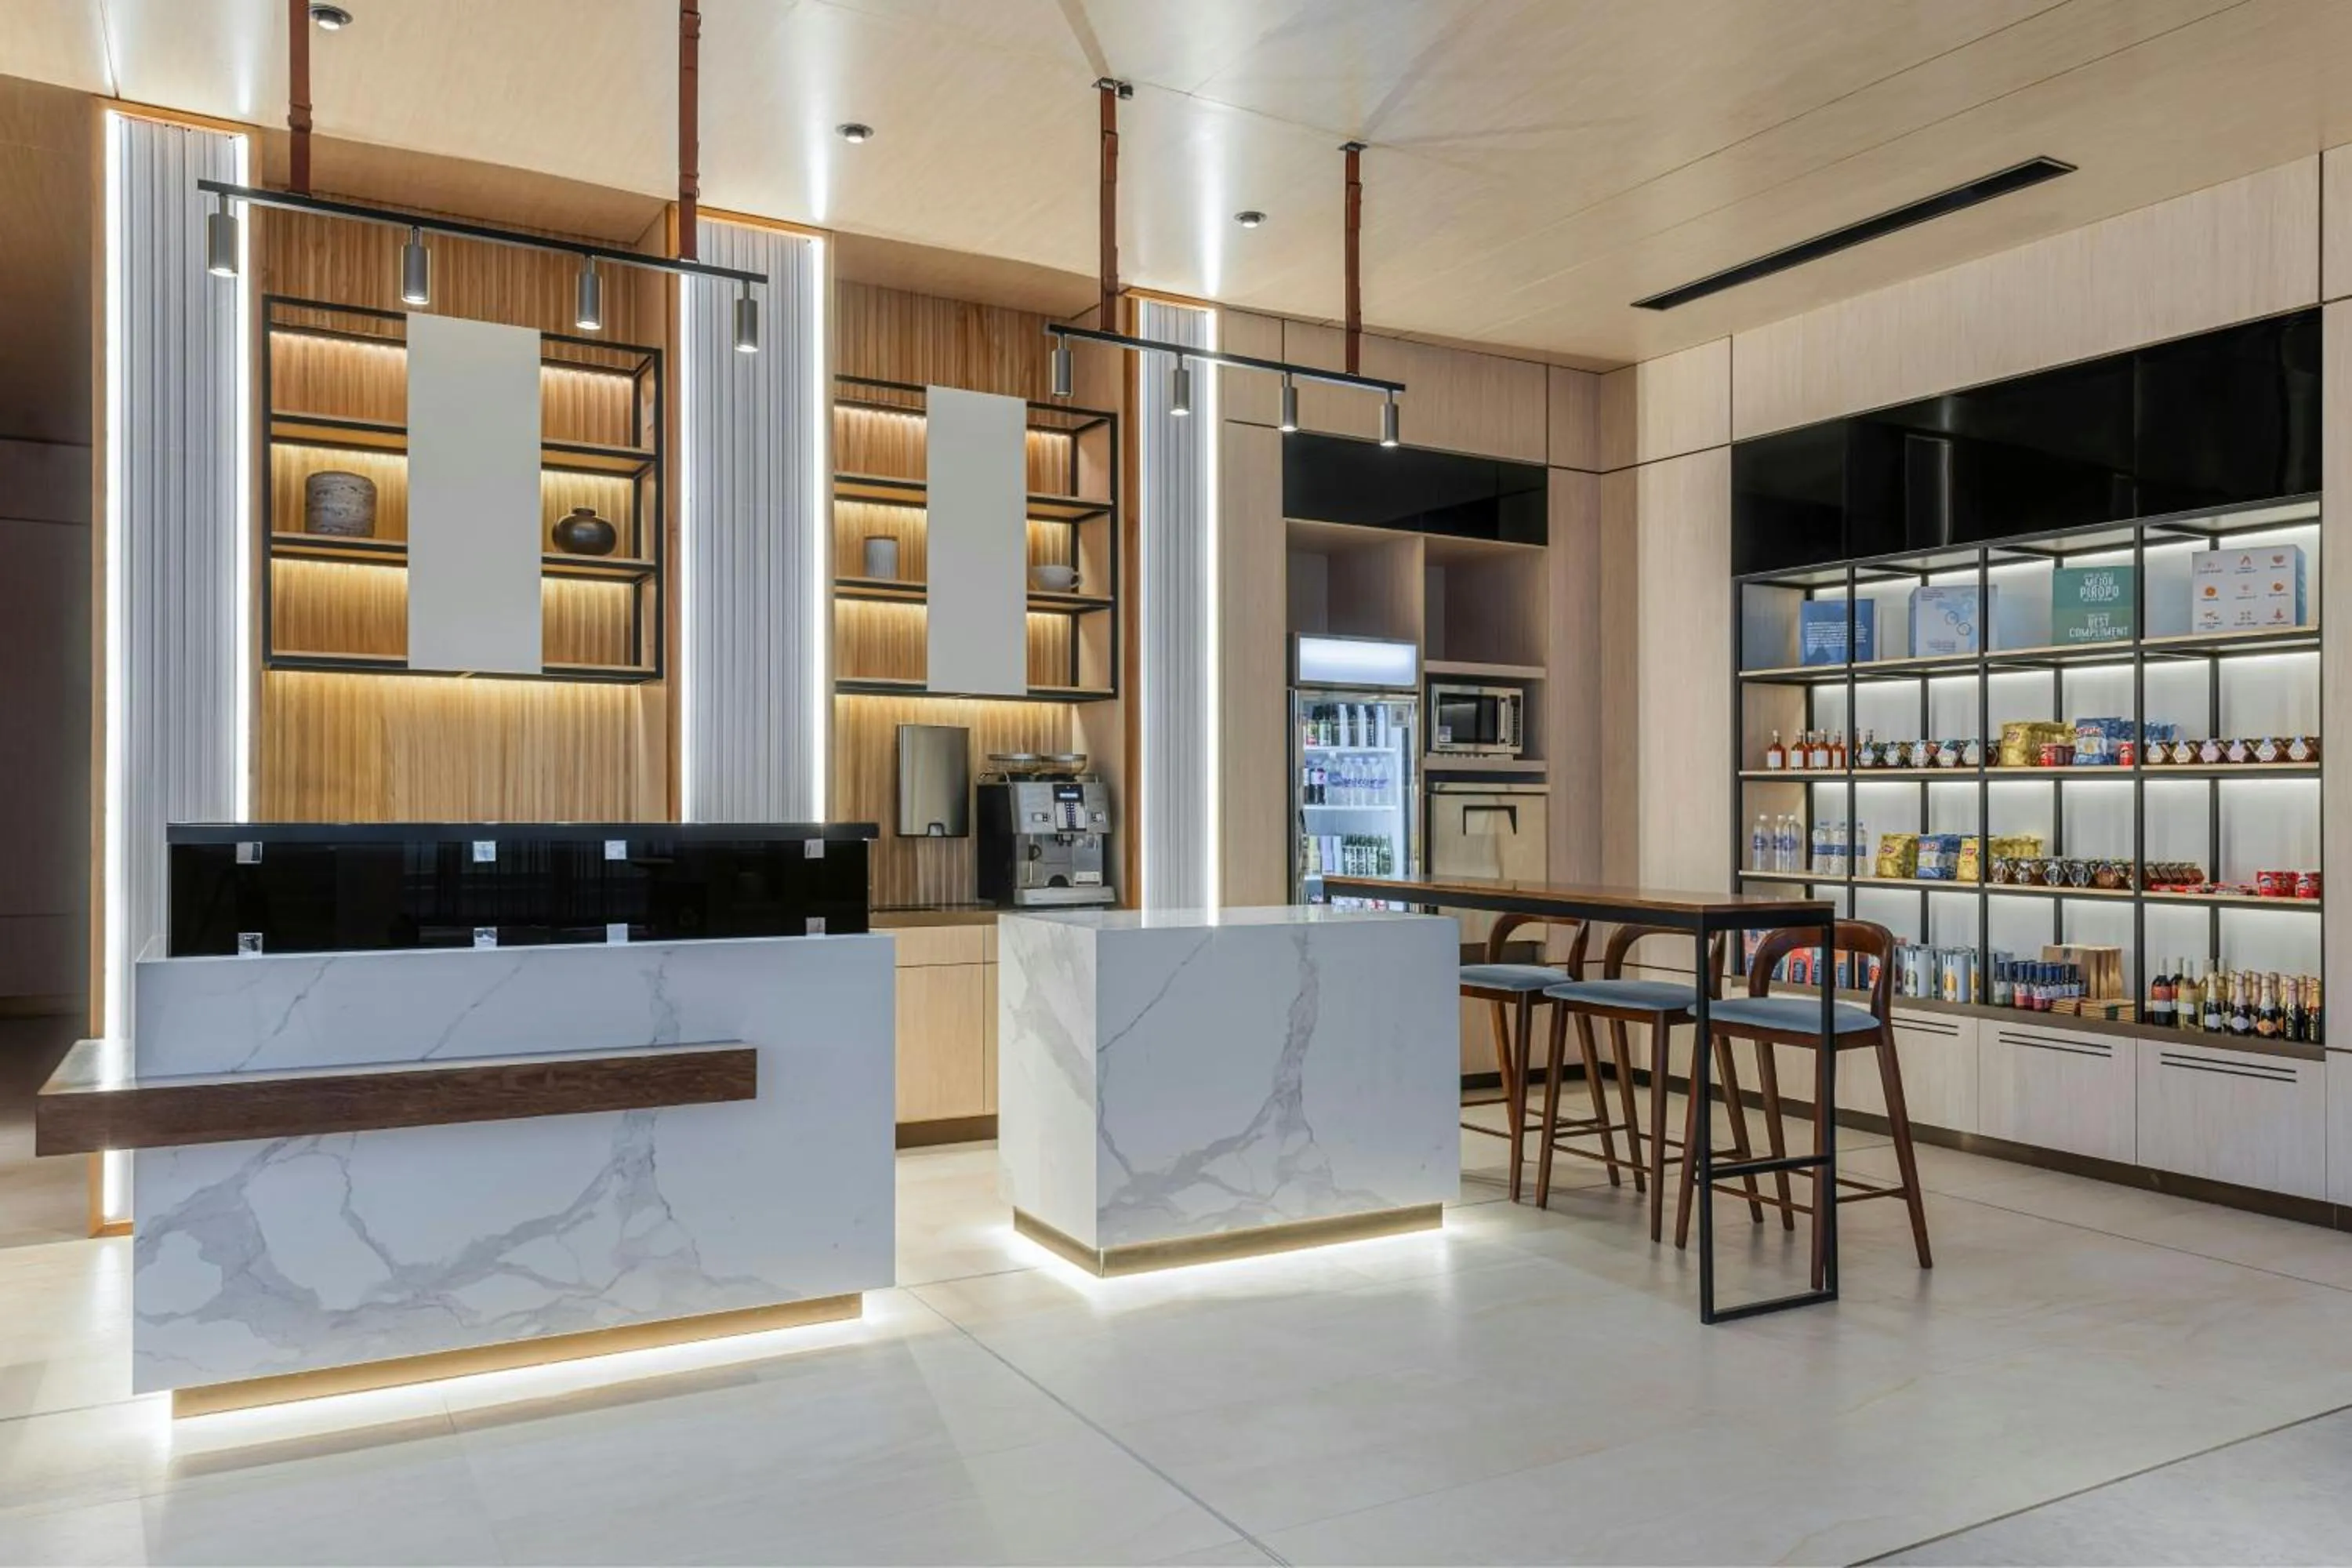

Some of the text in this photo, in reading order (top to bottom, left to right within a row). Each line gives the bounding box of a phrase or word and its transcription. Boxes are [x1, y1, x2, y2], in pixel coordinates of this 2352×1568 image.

[2080, 586, 2119, 598] PIROPO
[2088, 616, 2109, 627] BEST
[2070, 626, 2128, 637] COMPLIMENT
